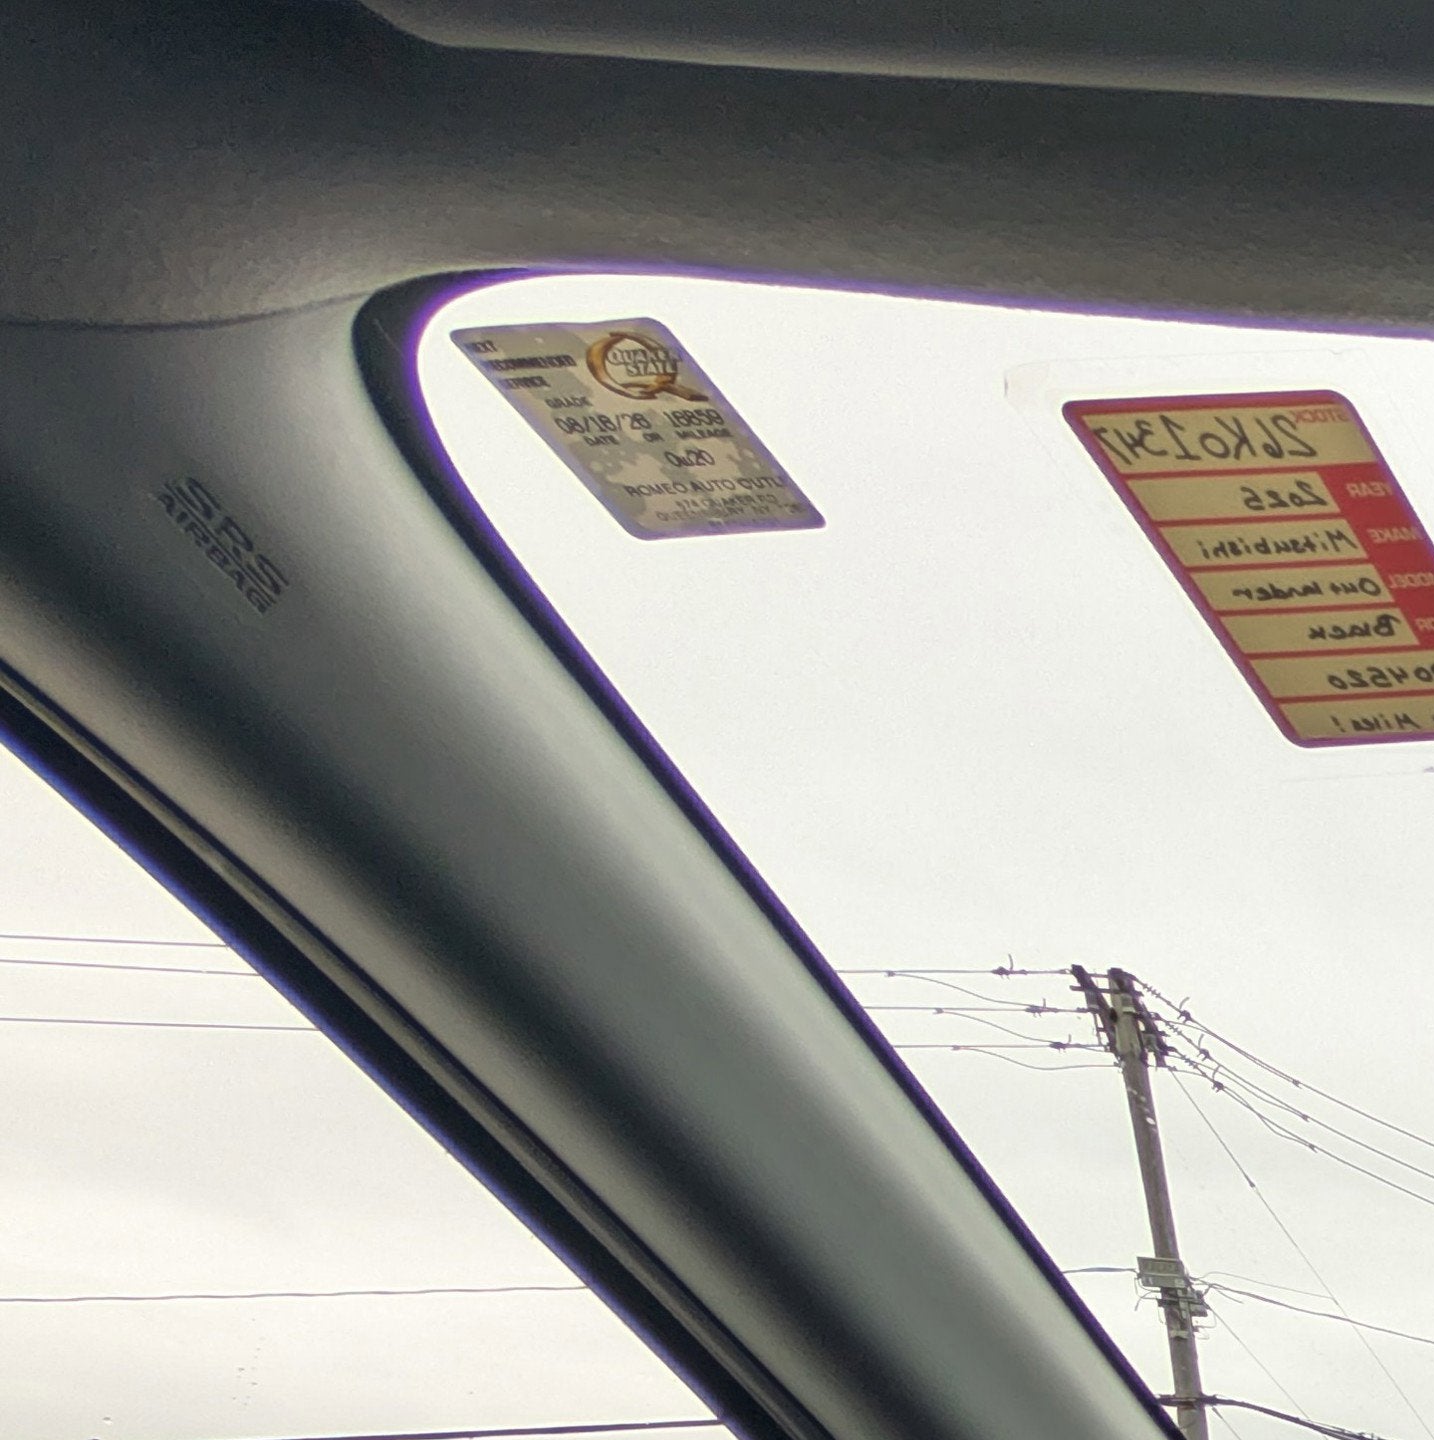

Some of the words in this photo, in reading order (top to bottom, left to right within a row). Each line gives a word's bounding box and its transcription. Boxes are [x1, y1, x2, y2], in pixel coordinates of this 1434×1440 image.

[584, 433, 621, 447] DATE
[624, 482, 688, 499] ROMEO
[691, 479, 737, 494] AUTO
